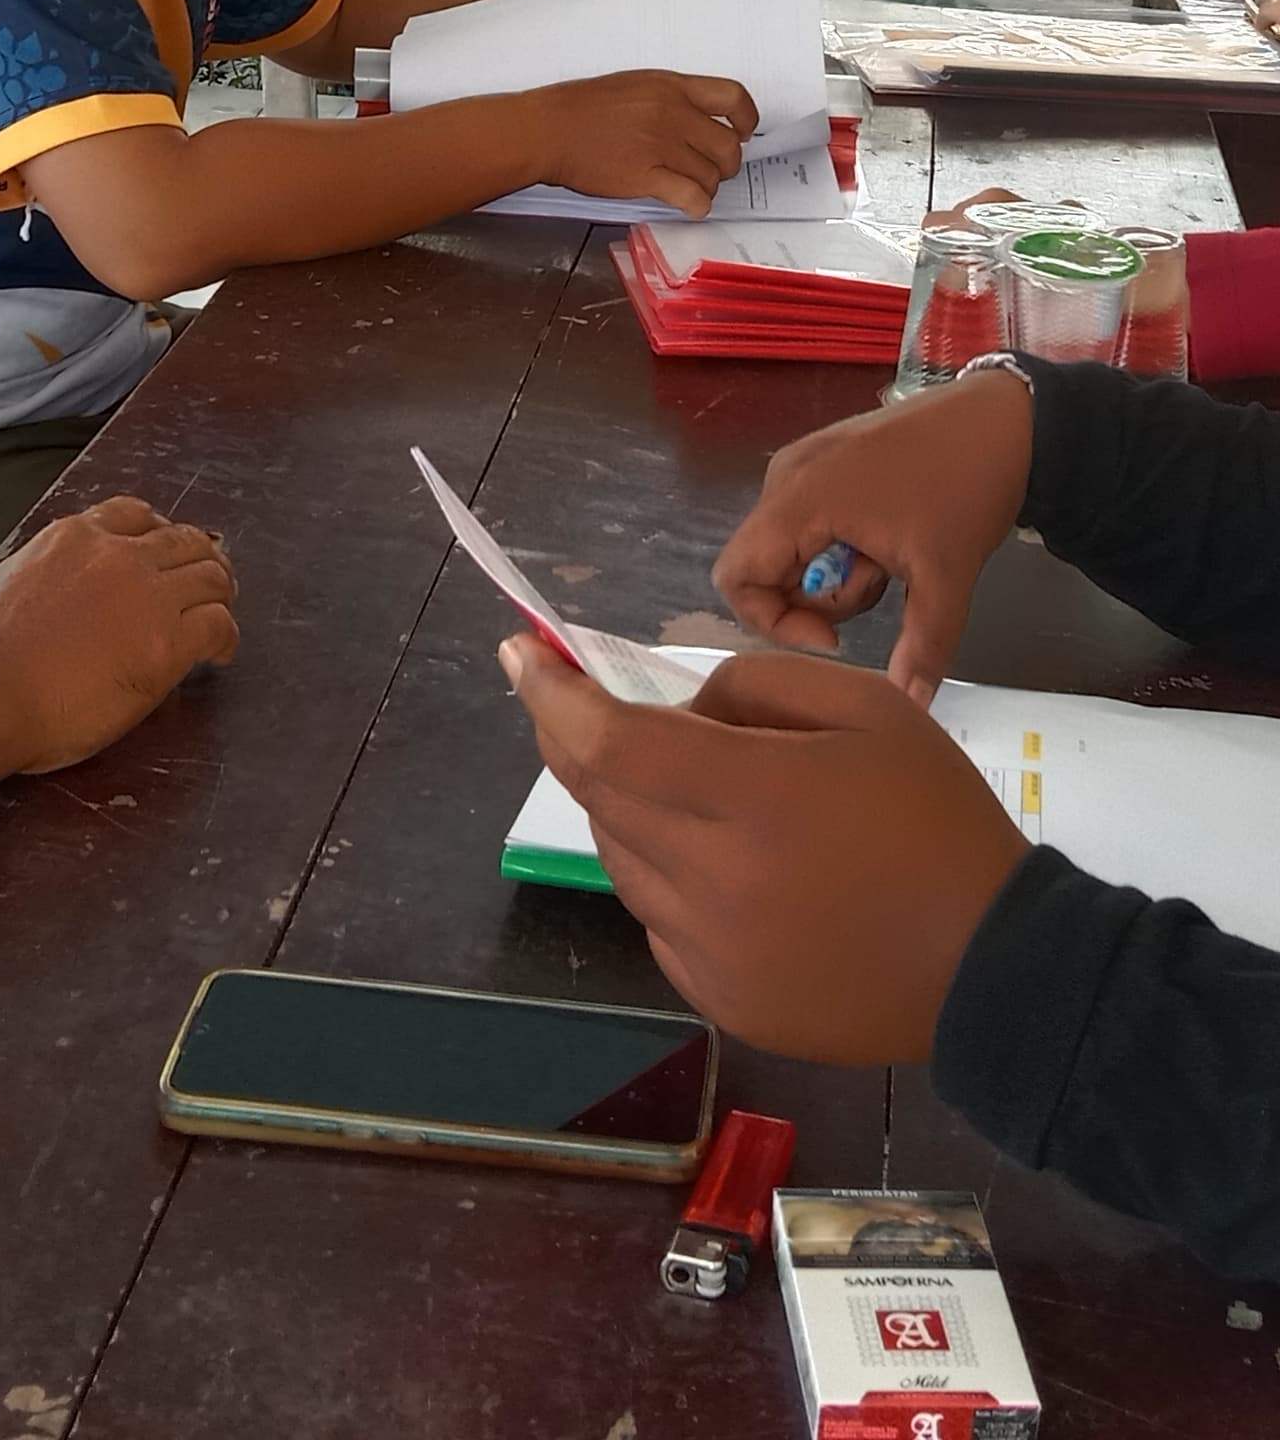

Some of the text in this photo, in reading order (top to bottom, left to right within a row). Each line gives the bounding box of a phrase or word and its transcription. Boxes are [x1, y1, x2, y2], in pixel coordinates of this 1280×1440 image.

[832, 1189, 919, 1199] PERINGATAN
[843, 1276, 954, 1287] SAMPOERNA
[900, 1374, 950, 1389] Mild
